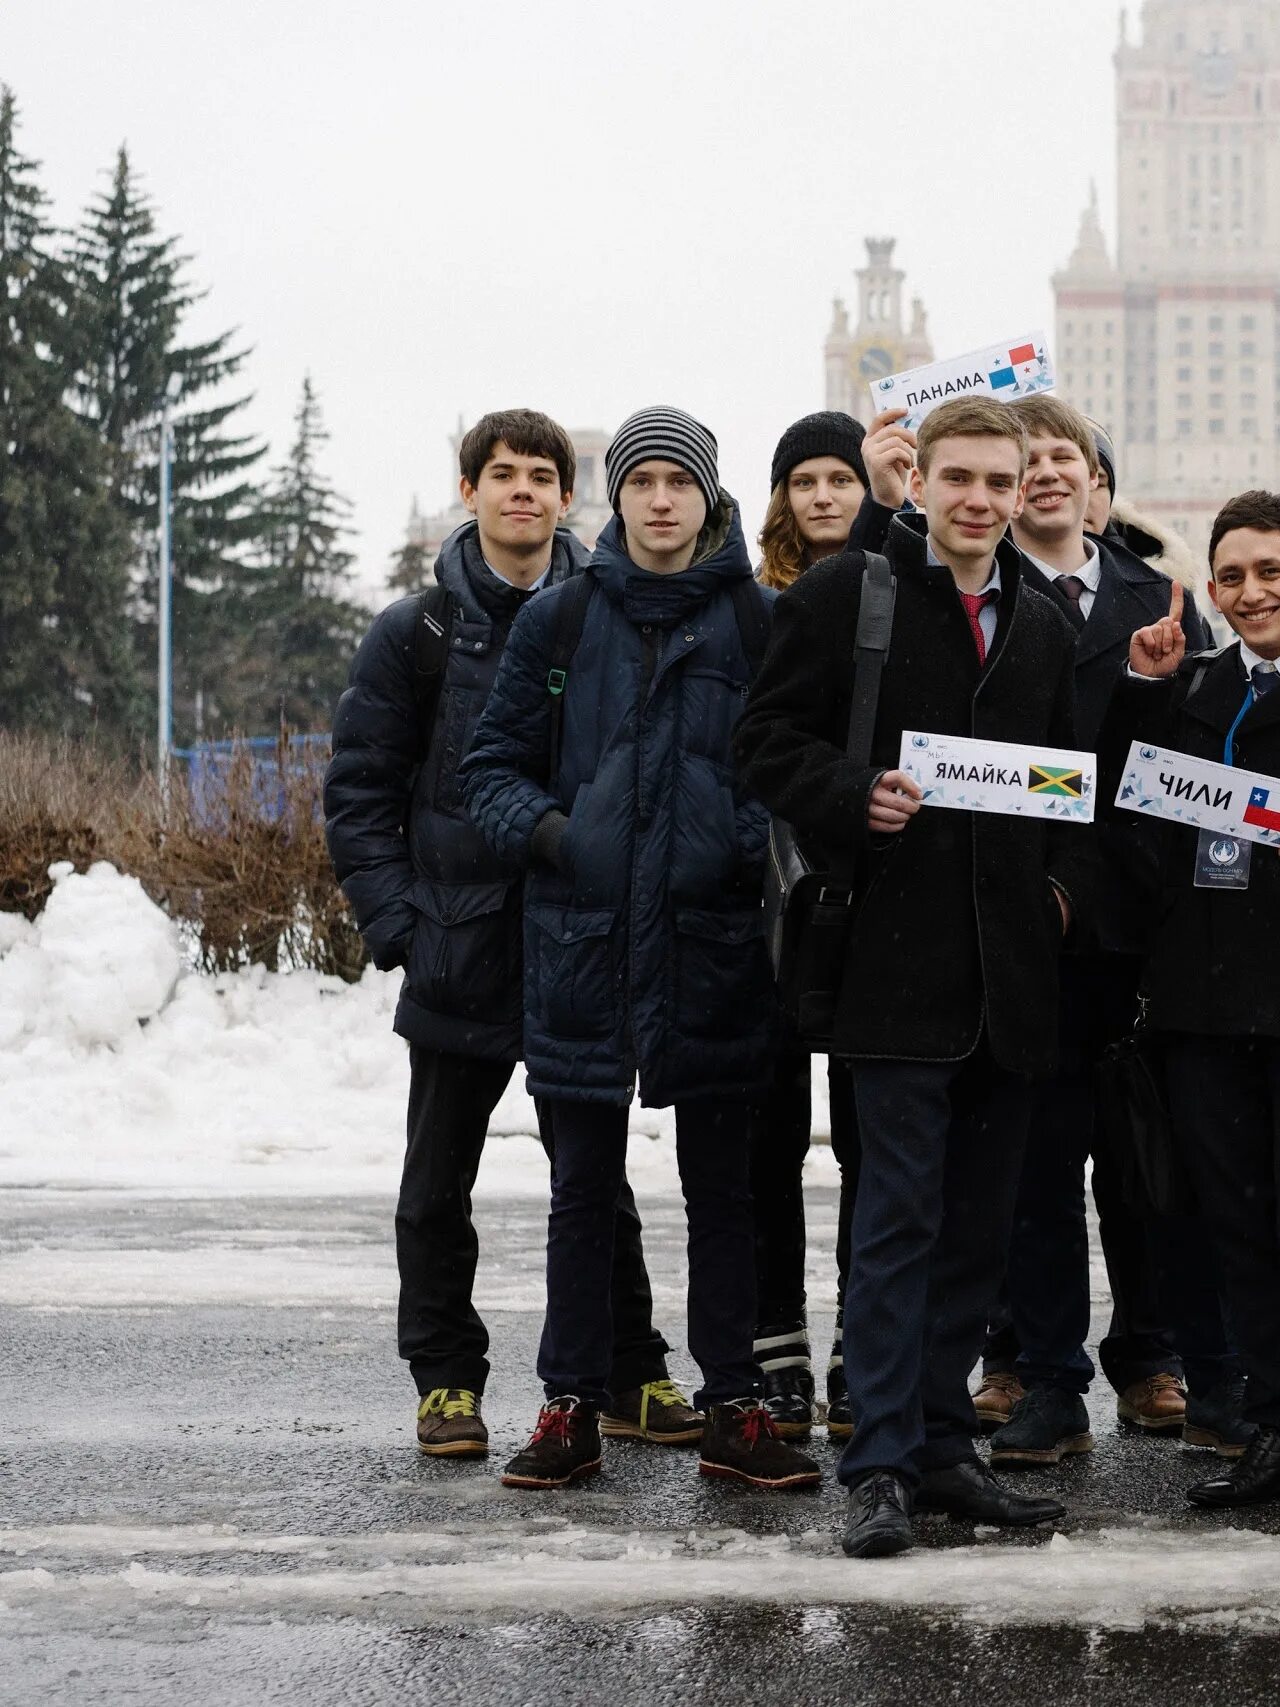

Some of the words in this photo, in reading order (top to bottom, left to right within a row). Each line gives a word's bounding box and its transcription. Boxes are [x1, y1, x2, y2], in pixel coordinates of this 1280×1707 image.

[906, 372, 985, 407] ПАНАМА
[935, 762, 1023, 787] ЯМАЙКА
[1159, 772, 1233, 811] ЧИЛИ
